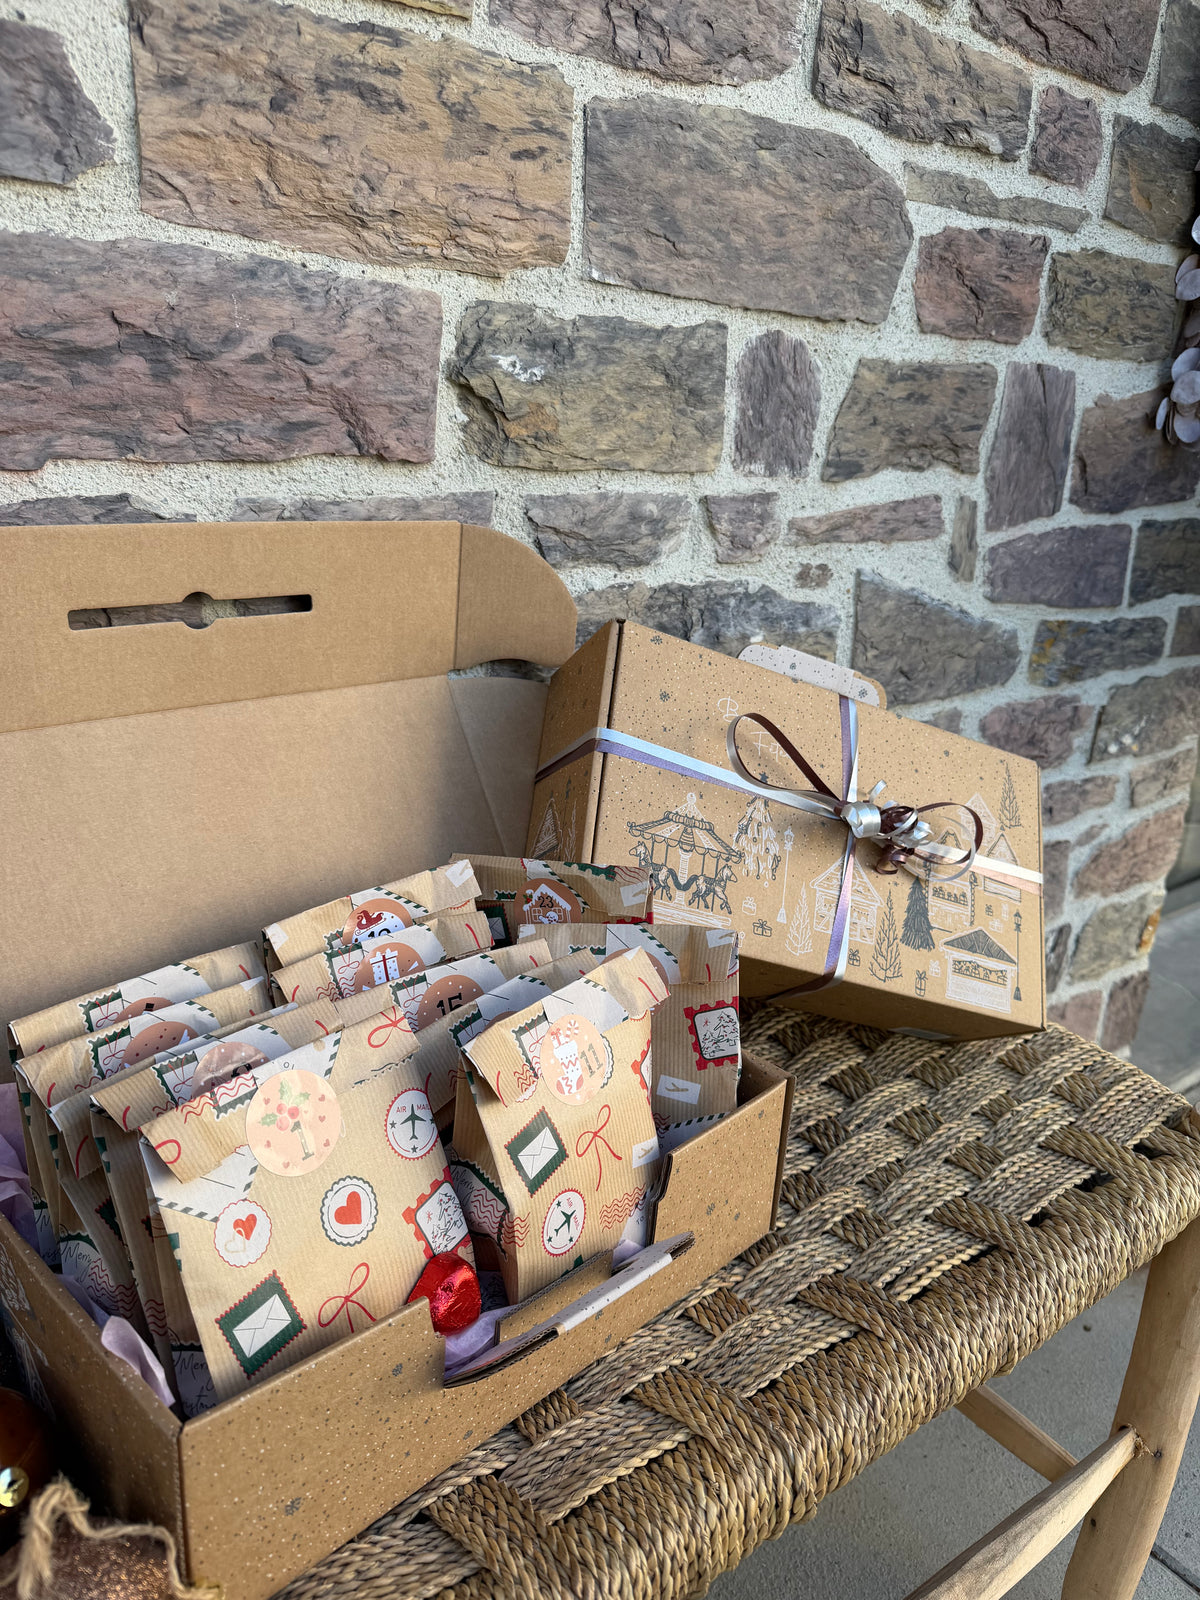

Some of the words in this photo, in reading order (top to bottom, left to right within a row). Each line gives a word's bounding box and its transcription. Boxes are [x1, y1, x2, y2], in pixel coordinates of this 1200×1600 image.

[538, 895, 554, 908] 23
[580, 1043, 604, 1078] 11
[396, 1105, 407, 1113] AIR
[290, 1120, 315, 1160] 1
[566, 1197, 574, 1209] AIR
